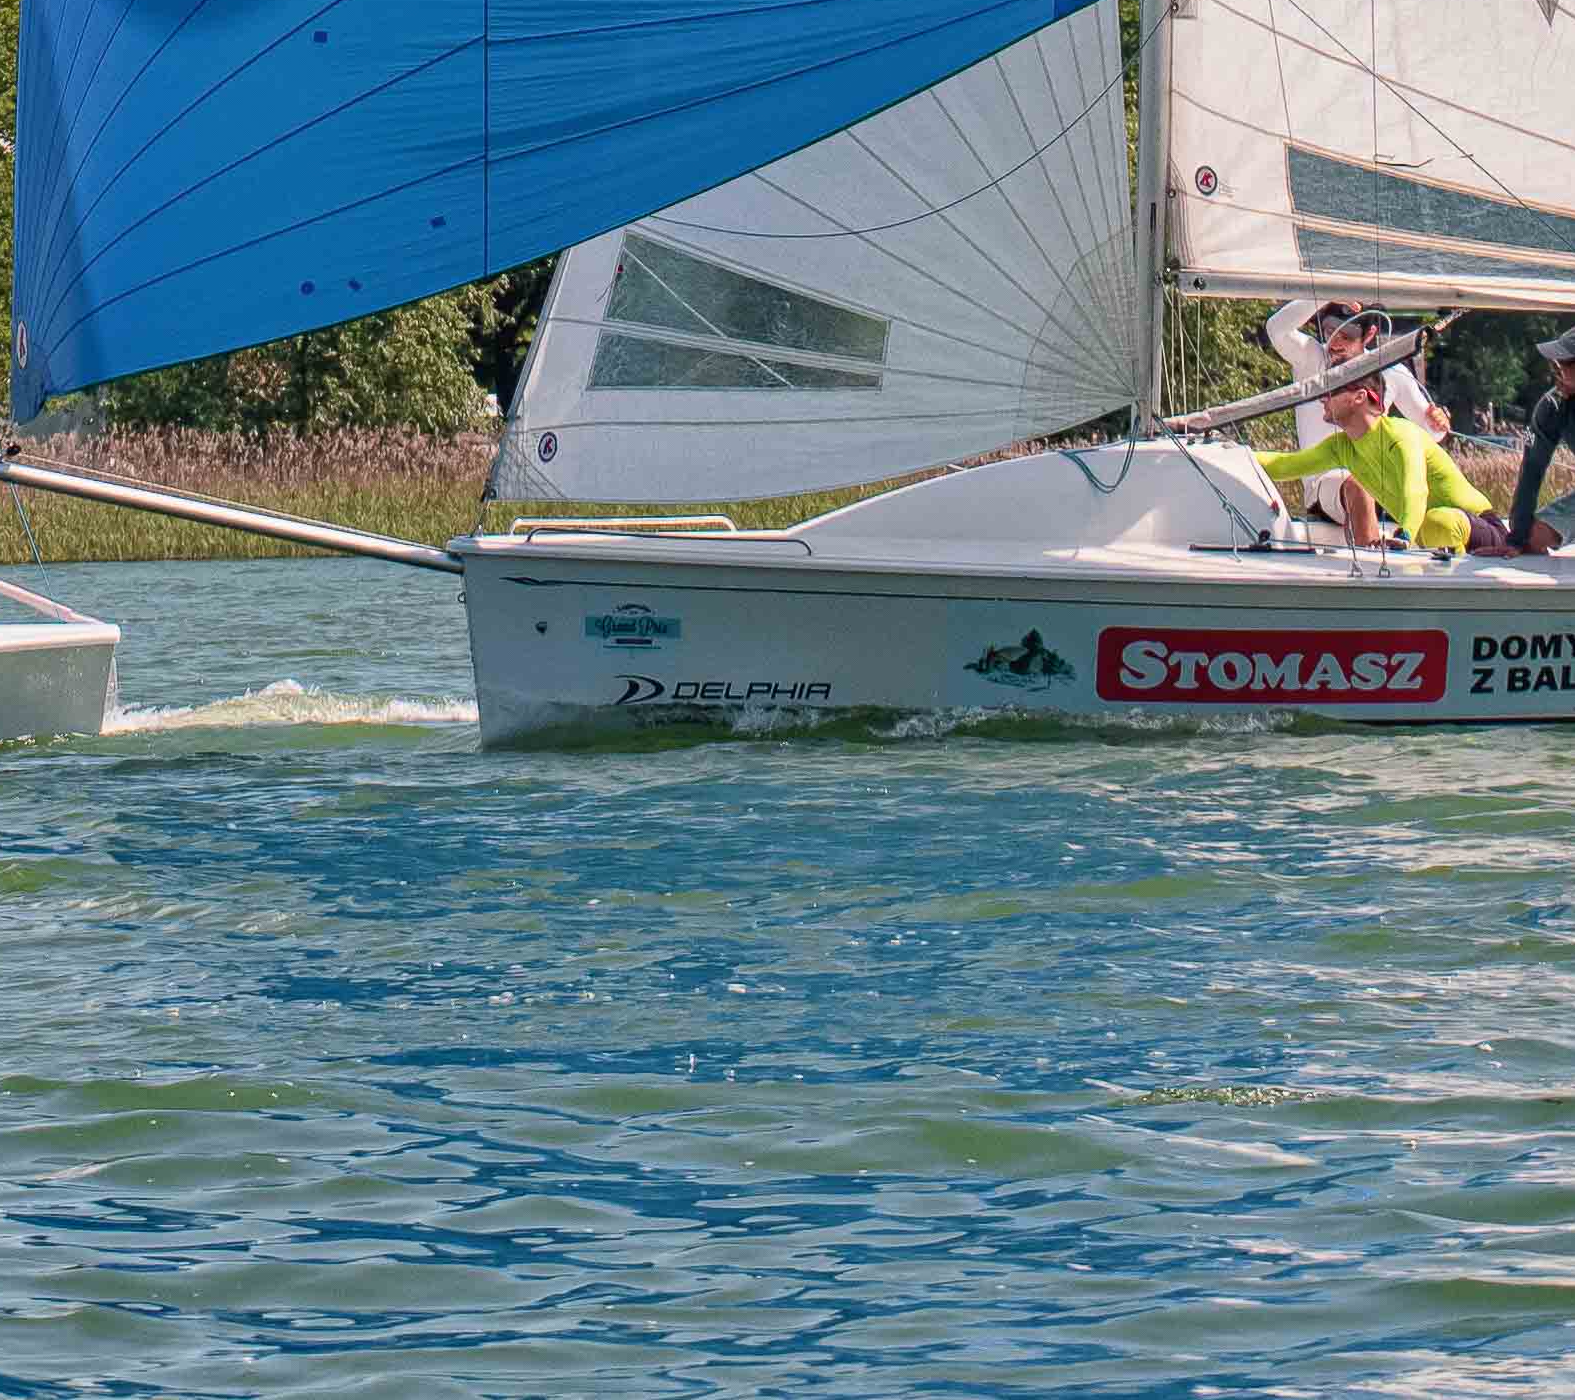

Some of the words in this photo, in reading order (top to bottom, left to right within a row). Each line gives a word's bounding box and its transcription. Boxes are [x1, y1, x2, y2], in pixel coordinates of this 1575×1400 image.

[1119, 640, 1428, 693] STOMASZ
[671, 680, 831, 701] DELPHIA
[1470, 667, 1495, 694] Z
